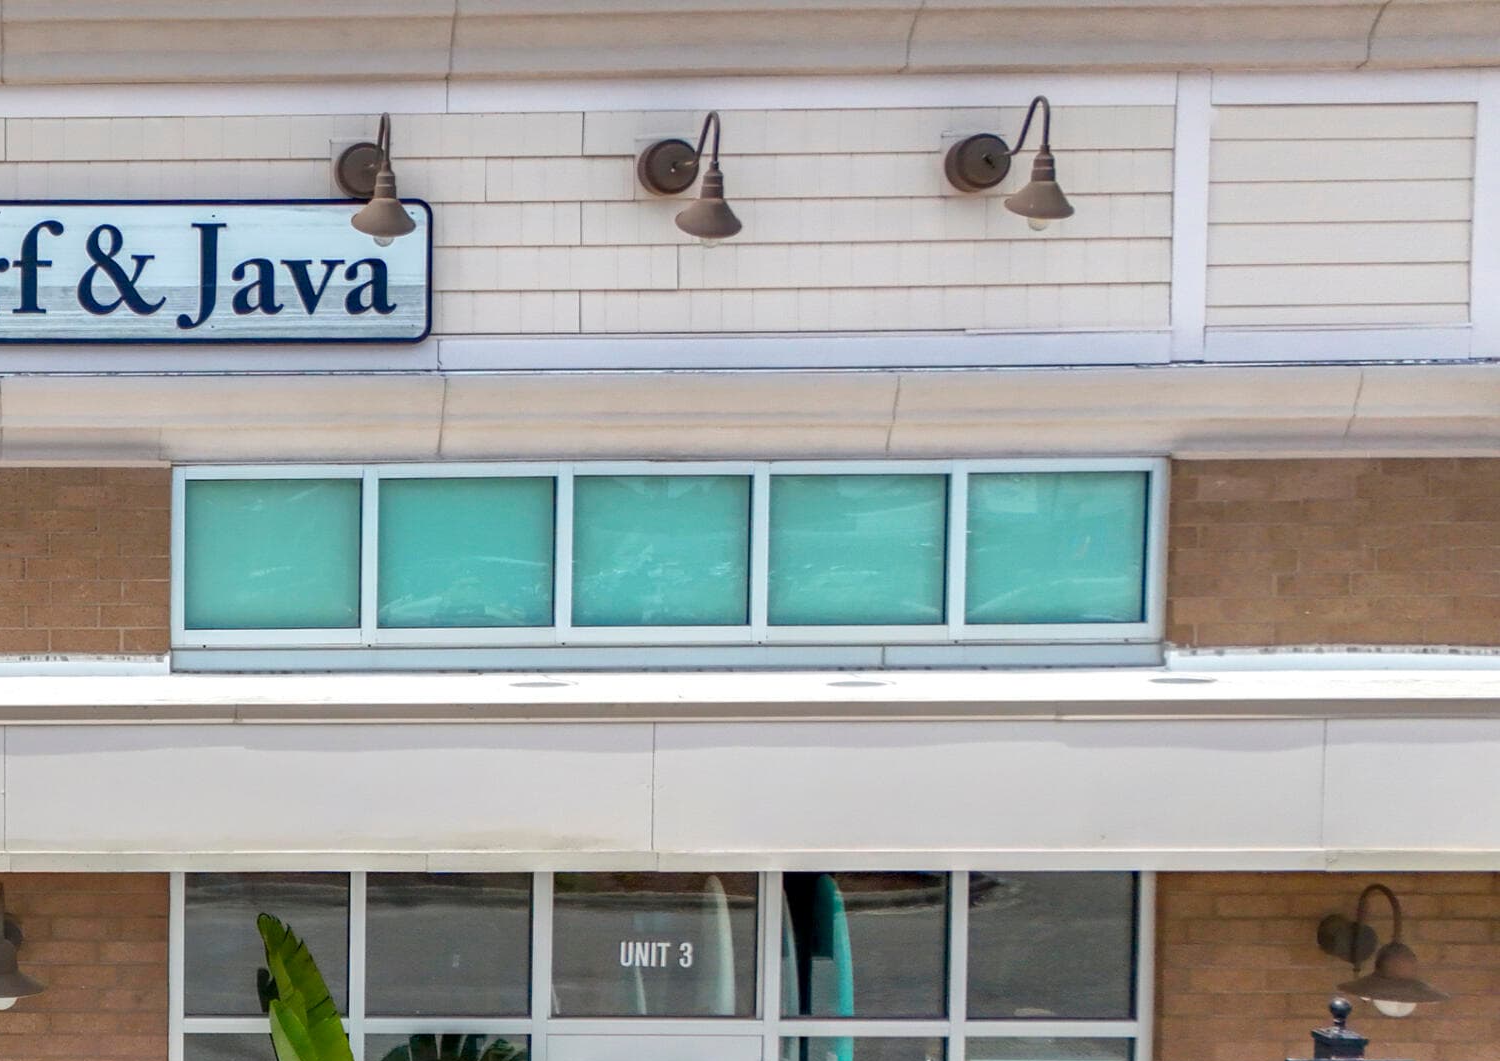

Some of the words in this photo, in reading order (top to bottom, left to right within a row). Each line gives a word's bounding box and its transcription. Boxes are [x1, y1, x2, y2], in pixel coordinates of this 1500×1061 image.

[76, 223, 167, 316] &
[176, 222, 398, 330] Java
[620, 941, 671, 967] UNIT
[679, 942, 693, 968] 3
